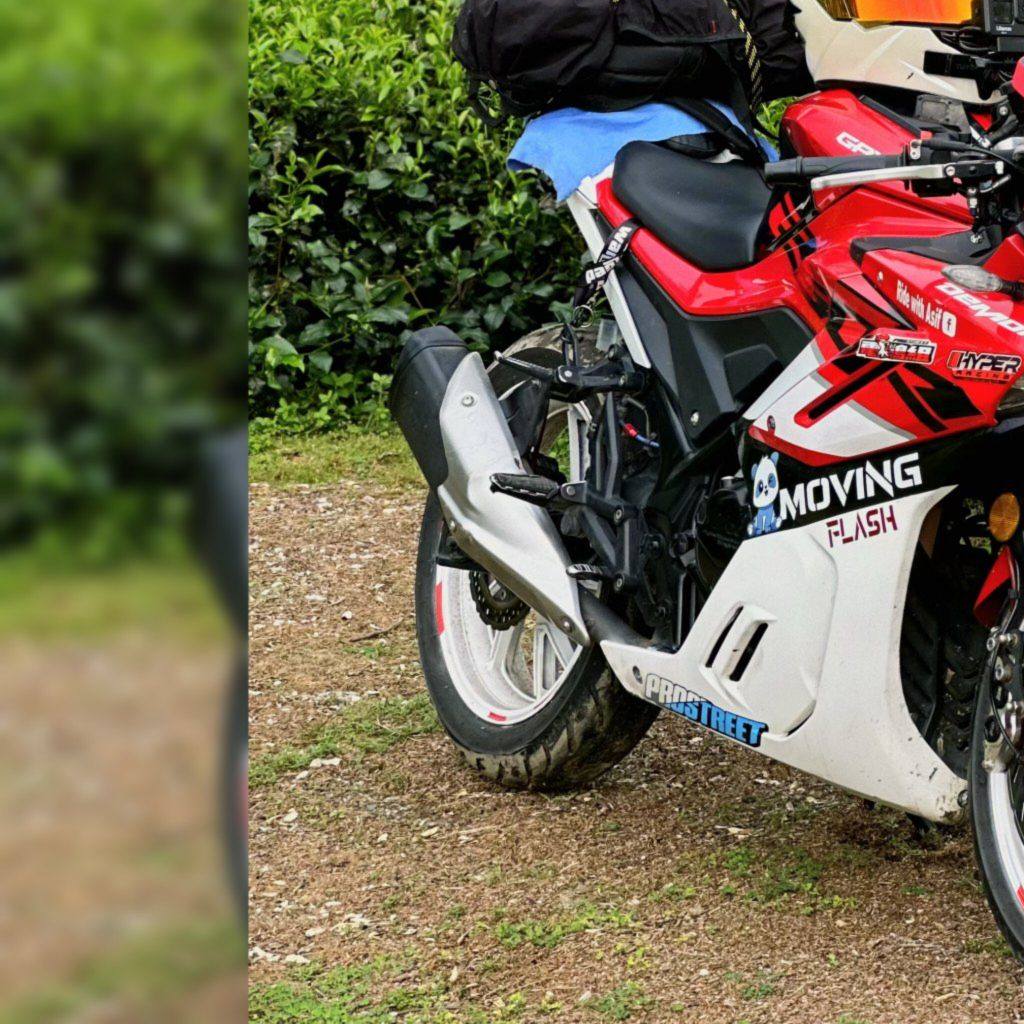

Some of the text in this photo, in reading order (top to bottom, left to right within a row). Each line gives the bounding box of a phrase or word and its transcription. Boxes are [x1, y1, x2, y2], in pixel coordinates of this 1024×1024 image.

[836, 131, 882, 156] GP
[896, 280, 943, 330] Ride with Asif
[957, 352, 1022, 373] HYPER
[779, 452, 923, 521] MOVING
[826, 505, 898, 548] FLASH
[645, 674, 768, 746] PROSTREET
